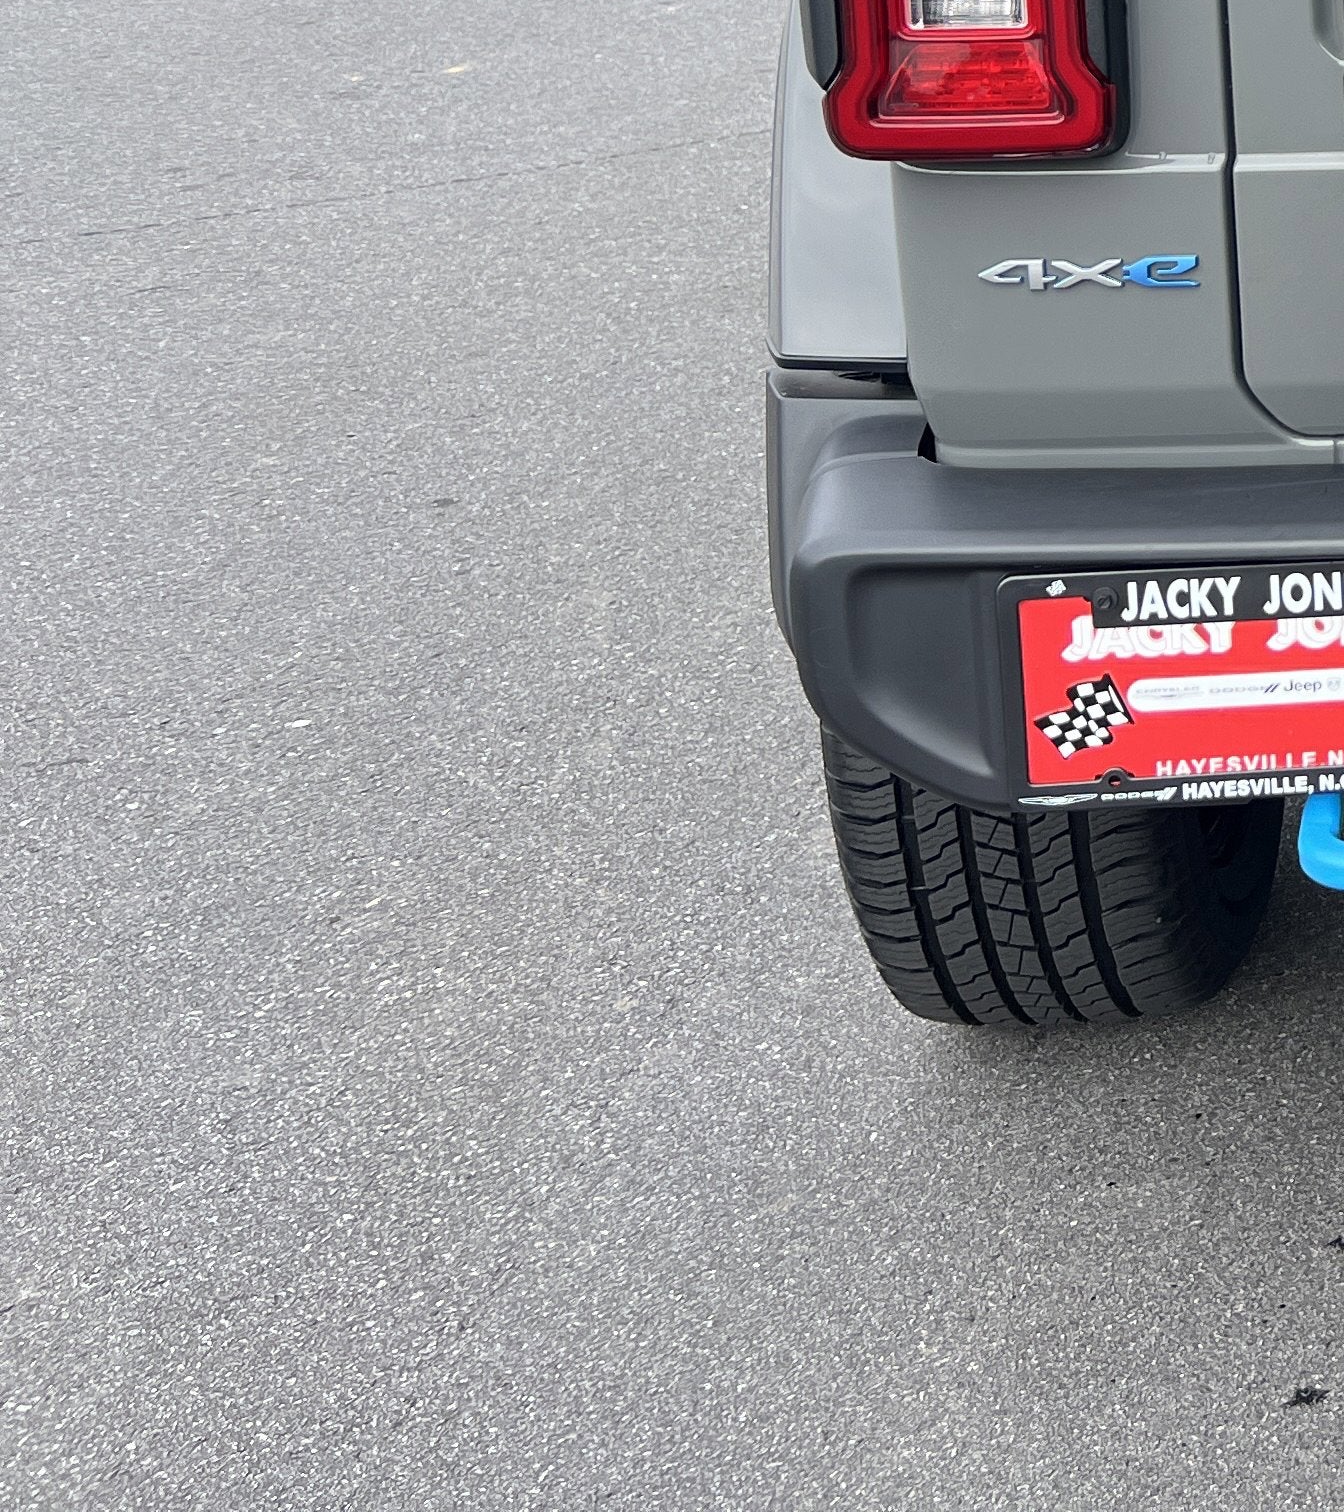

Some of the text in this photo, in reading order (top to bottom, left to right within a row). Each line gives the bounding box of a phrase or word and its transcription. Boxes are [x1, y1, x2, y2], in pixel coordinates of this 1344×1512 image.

[1121, 576, 1242, 622] JACKY
[1061, 614, 1238, 663] JACKY
[1283, 679, 1323, 694] Jeep
[1182, 775, 1315, 801] HAYESVILLE,
